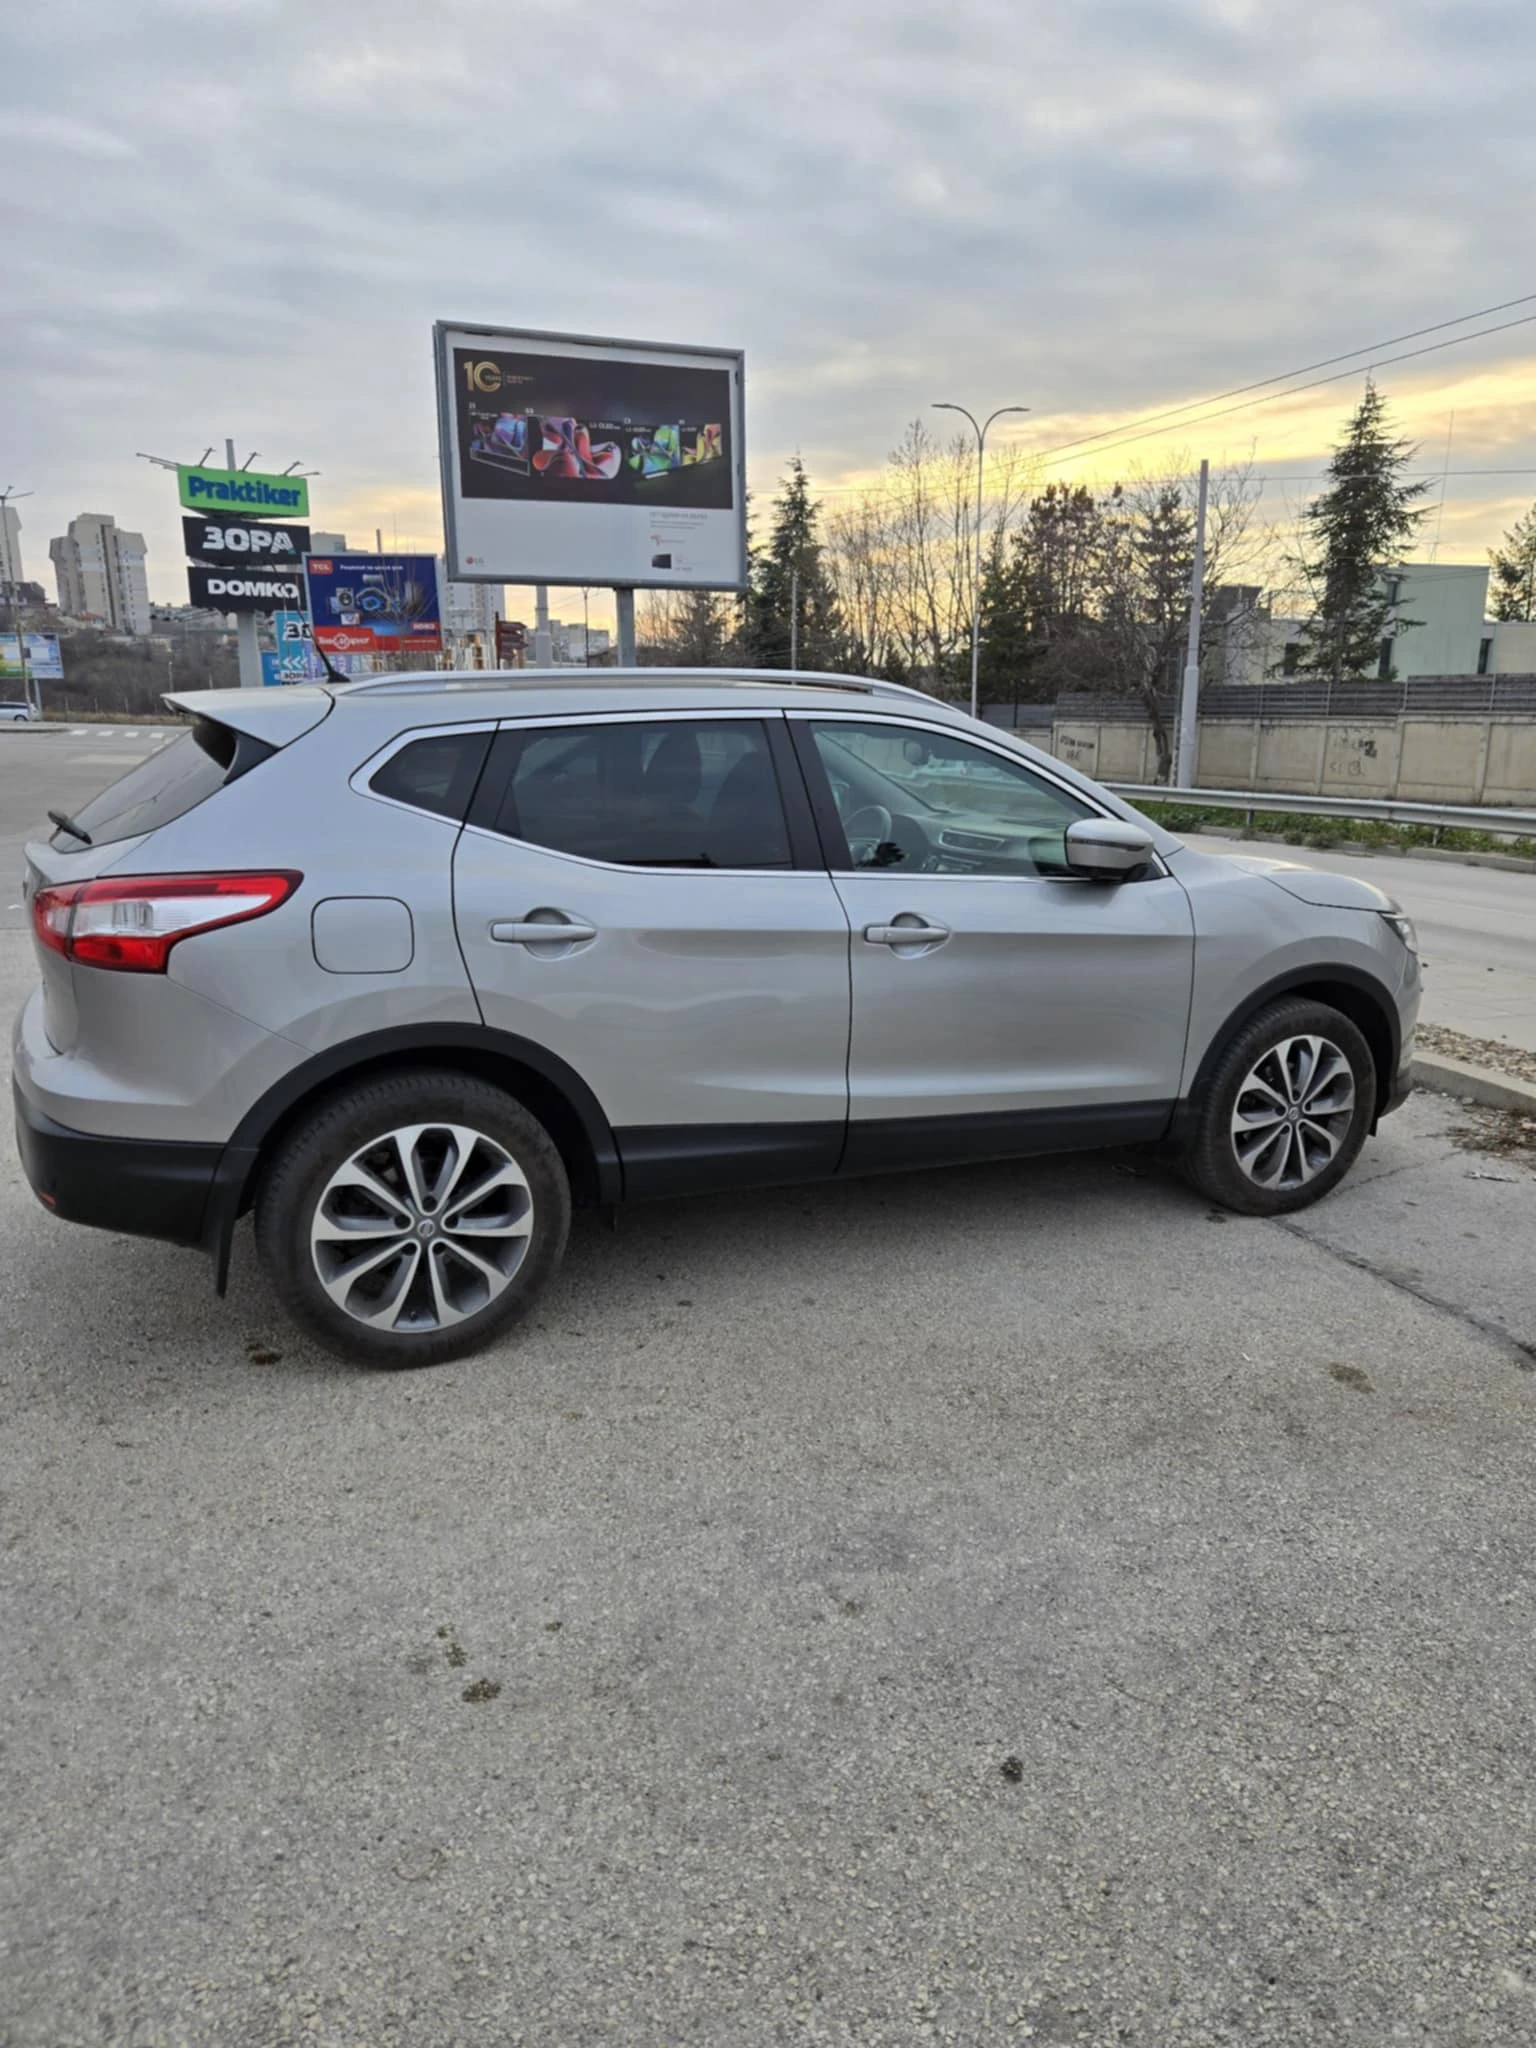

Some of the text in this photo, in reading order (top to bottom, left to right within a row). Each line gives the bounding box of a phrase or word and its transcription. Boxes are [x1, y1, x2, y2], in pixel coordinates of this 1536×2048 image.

[188, 476, 301, 507] Praktiker
[202, 525, 296, 555] ЗОРА
[312, 563, 330, 571] TCL
[207, 578, 300, 599] DOMKO
